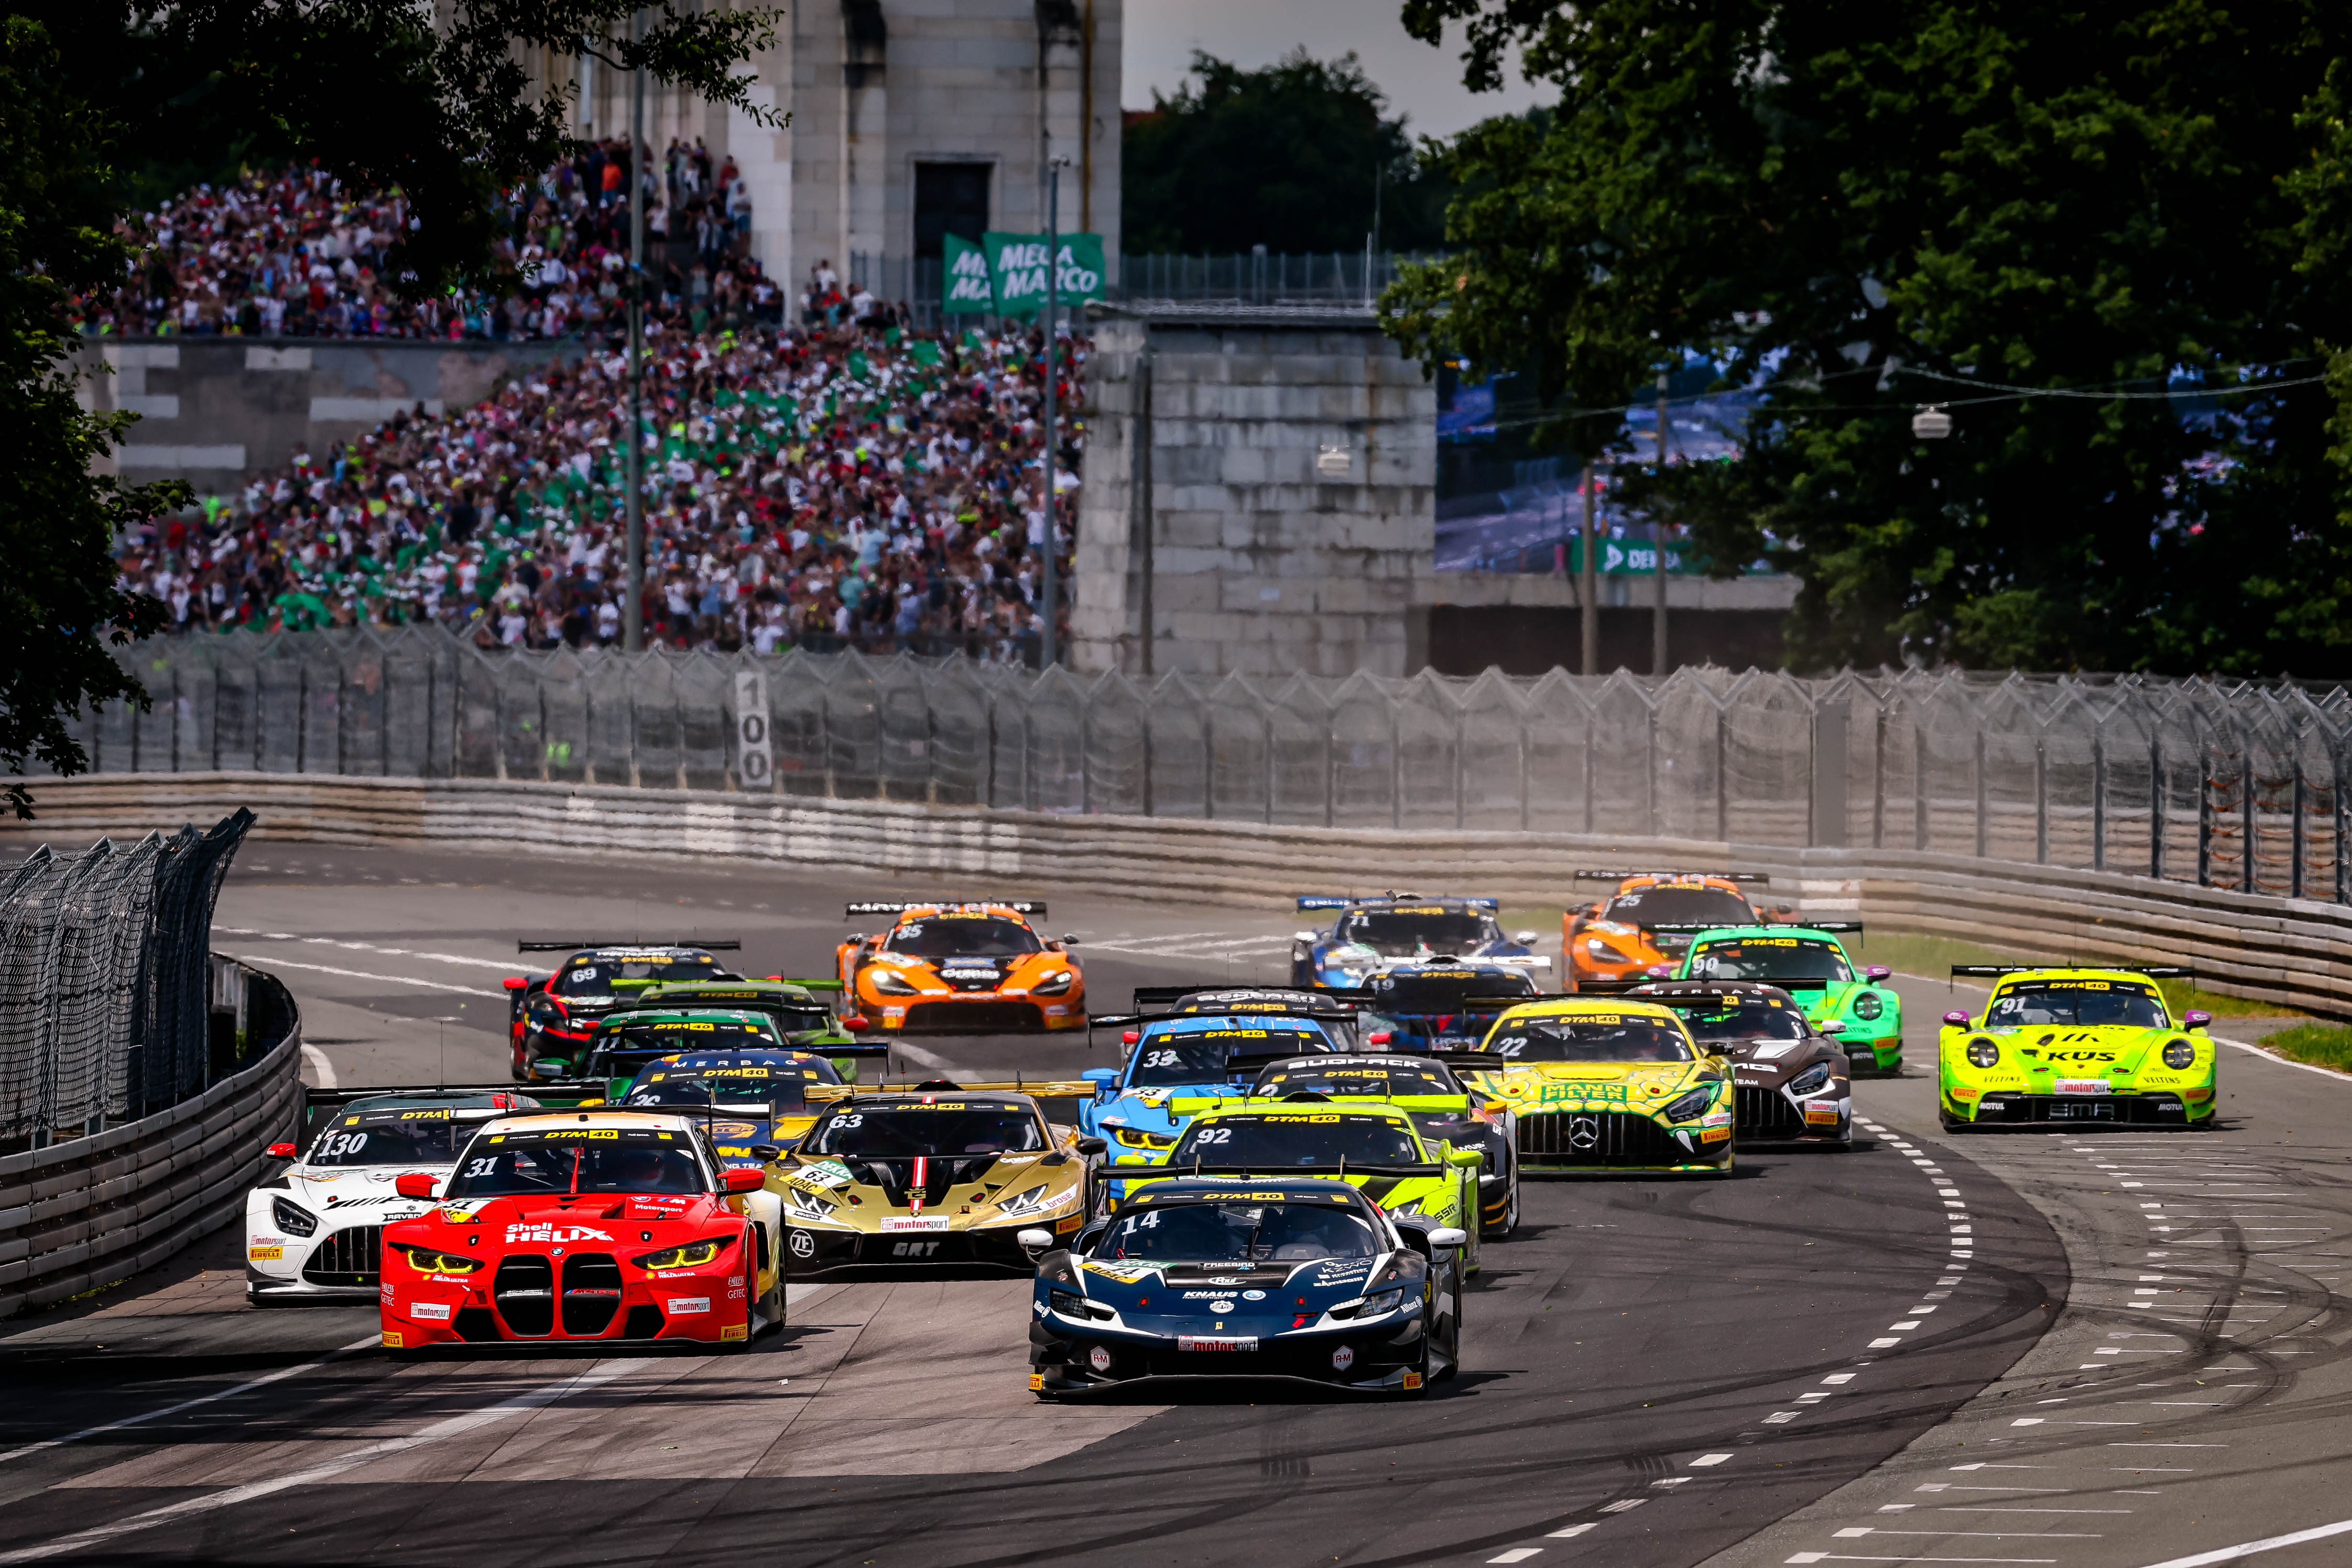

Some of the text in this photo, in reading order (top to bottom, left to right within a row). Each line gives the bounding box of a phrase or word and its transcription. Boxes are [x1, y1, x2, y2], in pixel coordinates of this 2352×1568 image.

[743, 678, 767, 779] 100
[1693, 957, 1719, 974] 90
[571, 967, 597, 983] 69
[2000, 997, 2027, 1014] 91
[1498, 1037, 1528, 1057] 22
[1143, 1050, 1177, 1068] 33
[2047, 1051, 2116, 1062] KÜS
[672, 1060, 798, 1068] MERBAG
[1544, 1091, 1623, 1100] FILTER
[1954, 1088, 1976, 1097] PIRELLI
[829, 1114, 864, 1129] 63
[1196, 1128, 1232, 1144] 92
[317, 1133, 368, 1157] 130
[463, 1156, 498, 1178] 31
[815, 1160, 854, 1180] DEKRA
[804, 1171, 831, 1182] 63
[786, 1177, 818, 1192] ADAC
[1046, 1192, 1072, 1208] brose
[1433, 1203, 1456, 1222] SSR
[507, 1223, 552, 1233] Shell
[894, 1219, 948, 1229] motorsport
[1121, 1210, 1160, 1236] 14
[506, 1226, 614, 1243] HELIX
[256, 1237, 286, 1246] motorsport
[792, 1234, 812, 1253] ZF
[252, 1249, 280, 1258] PIRELLI
[892, 1242, 940, 1256] GRT
[1113, 1260, 1171, 1269] DEKRA
[1088, 1266, 1128, 1280] ADAC
[382, 1282, 395, 1293] ENDLESS
[727, 1276, 744, 1286] ENDLESS
[382, 1293, 395, 1306] GETEC
[727, 1289, 745, 1299] GETEC
[418, 1308, 449, 1318] motorsport
[677, 1302, 709, 1311] motorsport
[1400, 1301, 1418, 1314] Allianz
[724, 1326, 746, 1338] PIRELLI
[1093, 1354, 1108, 1364] R-M
[1336, 1354, 1351, 1363] R-M
